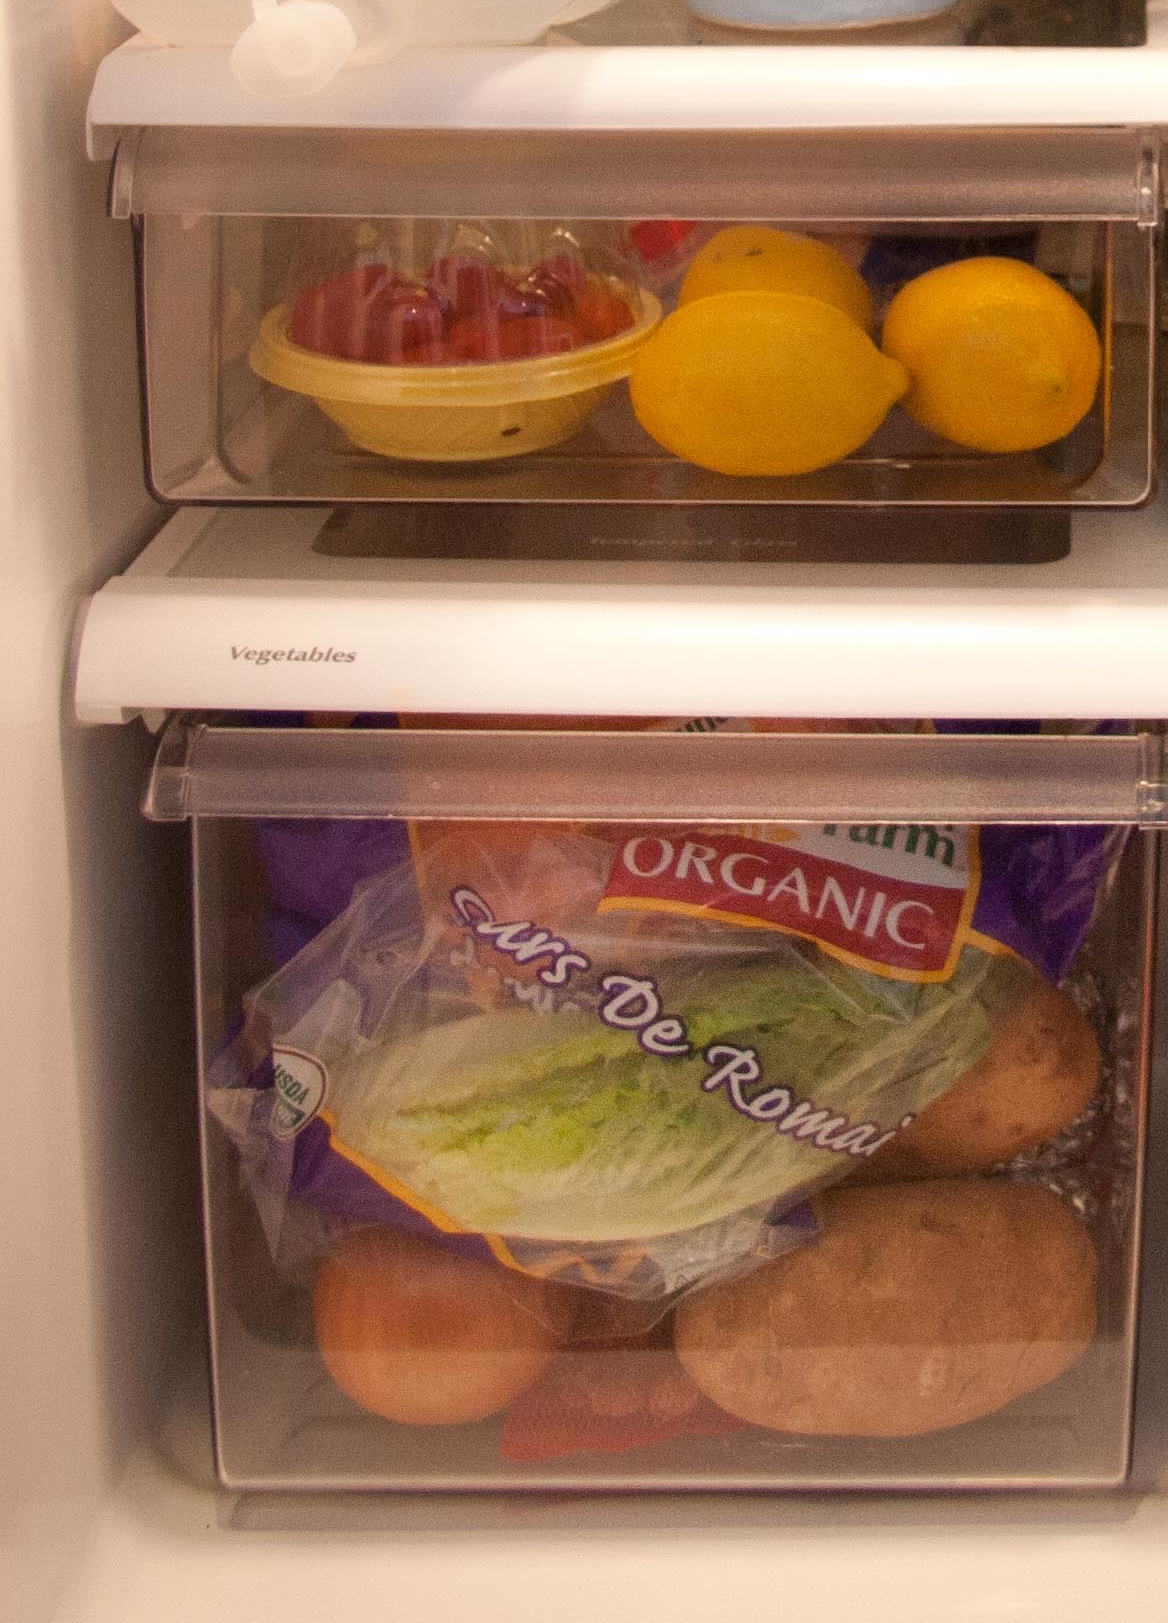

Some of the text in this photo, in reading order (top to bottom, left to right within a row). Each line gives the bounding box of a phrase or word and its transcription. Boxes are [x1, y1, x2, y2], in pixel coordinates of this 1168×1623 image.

[230, 645, 358, 666] Vegetables
[621, 835, 935, 952] ORGANIC
[600, 972, 691, 1058] De
